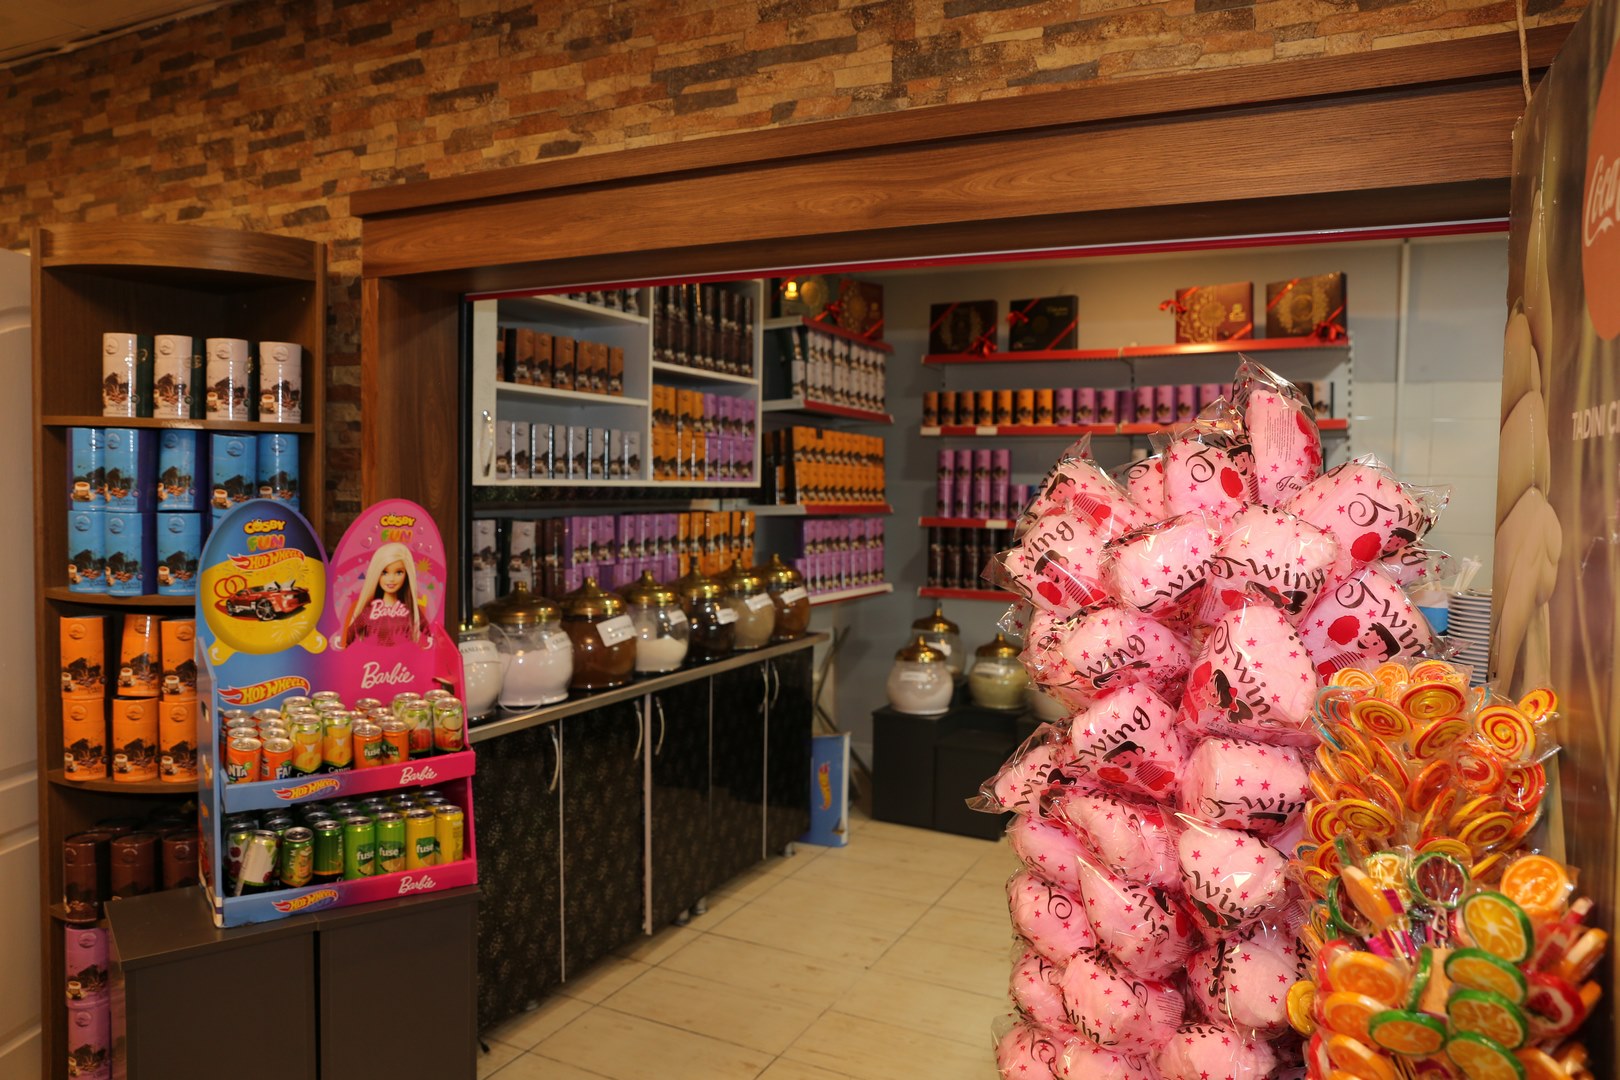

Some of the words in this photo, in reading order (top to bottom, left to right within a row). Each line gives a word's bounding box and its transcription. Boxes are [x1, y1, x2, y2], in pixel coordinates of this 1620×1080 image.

[1572, 404, 1606, 440] TADINI
[244, 519, 287, 534] COSBY
[380, 514, 415, 527] COSBY
[247, 534, 285, 552] FUN
[381, 529, 413, 543] FUN
[370, 599, 410, 620] Barbie
[1336, 577, 1426, 657] Twin
[361, 661, 414, 689] Barbie
[240, 683, 268, 704] HOT
[266, 677, 306, 694] WHEELS
[400, 766, 437, 784] Barbie
[1200, 793, 1306, 819] Twin
[398, 875, 436, 894] Barbie
